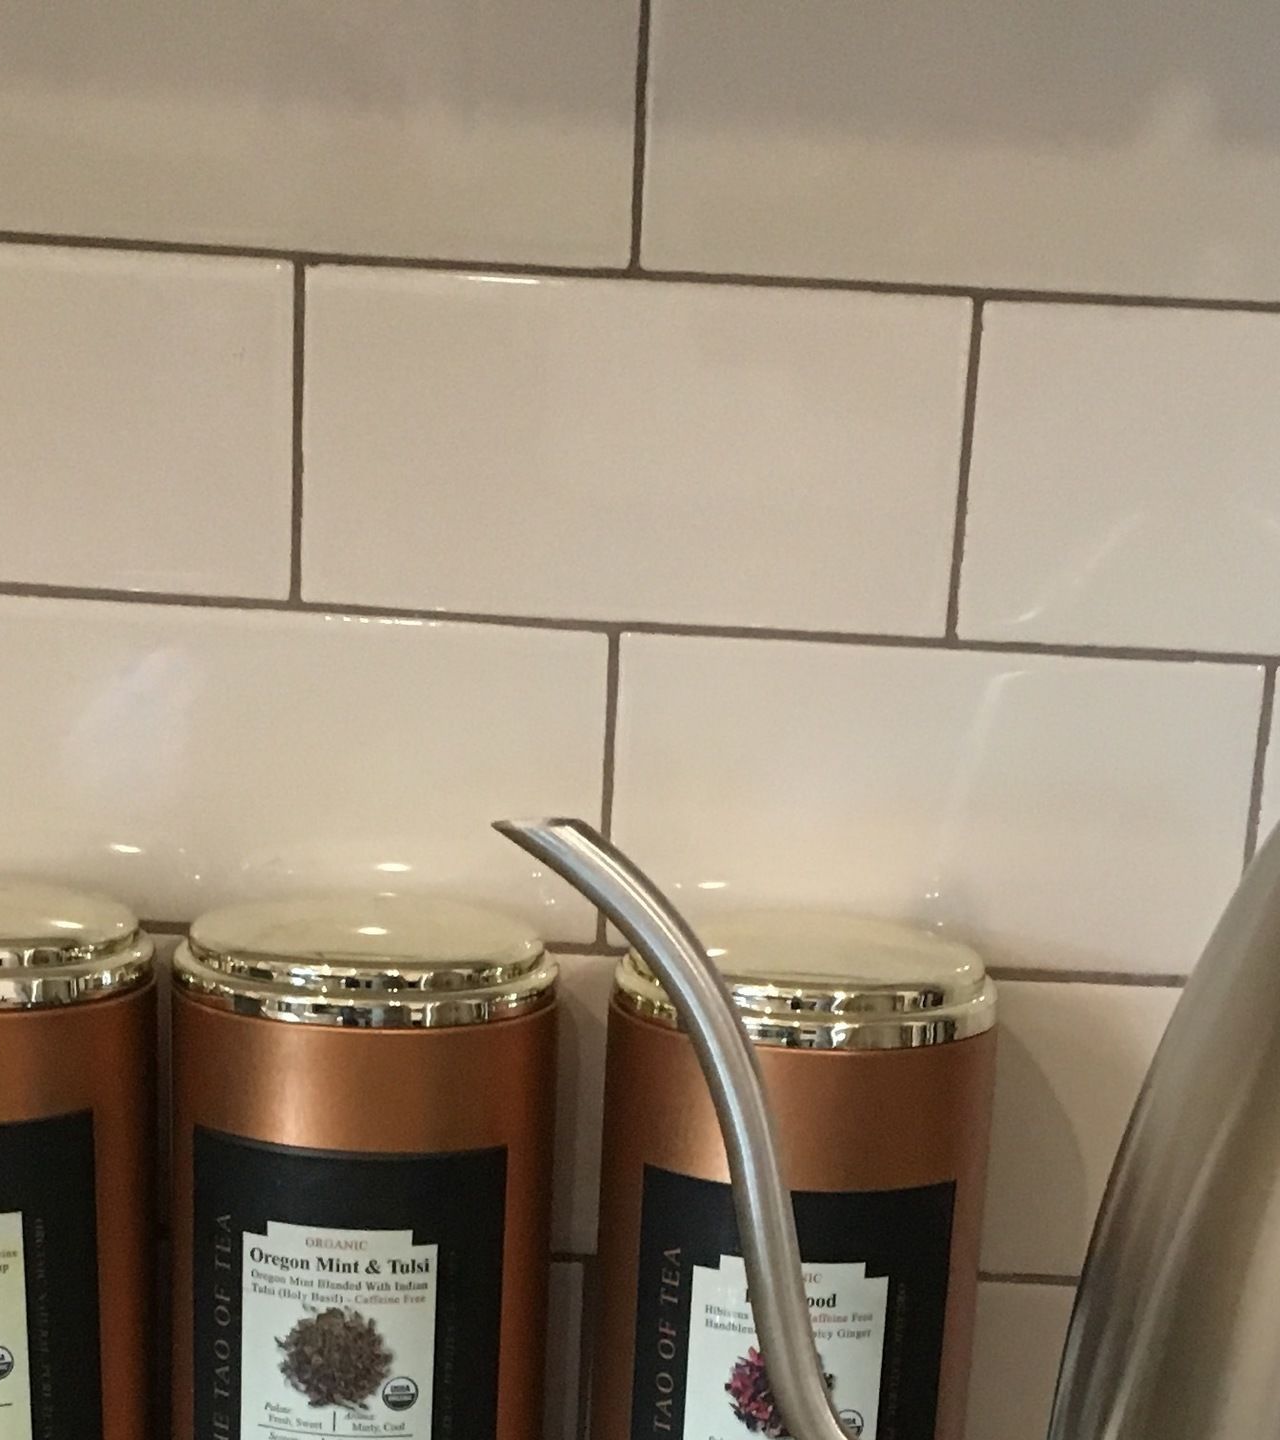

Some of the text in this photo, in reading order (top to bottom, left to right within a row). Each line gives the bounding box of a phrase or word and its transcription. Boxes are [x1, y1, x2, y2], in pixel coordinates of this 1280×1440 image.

[216, 1212, 232, 1271] TEA
[305, 1238, 368, 1251] ORGANIC
[250, 1247, 430, 1274] Oregon Mint & Tulsi
[251, 1269, 428, 1290] Oregon Mint Blended With Indian
[660, 1247, 682, 1305] TEA
[214, 1286, 232, 1327] OF
[252, 1284, 425, 1304] Tulsi (Holy Basil) Caffeine Free
[811, 1314, 848, 1322] affeine
[657, 1322, 677, 1359] OF
[837, 1329, 871, 1339] Ginger
[213, 1339, 231, 1399] TAO
[652, 1370, 674, 1430] TAO
[383, 1422, 405, 1431] Cool
